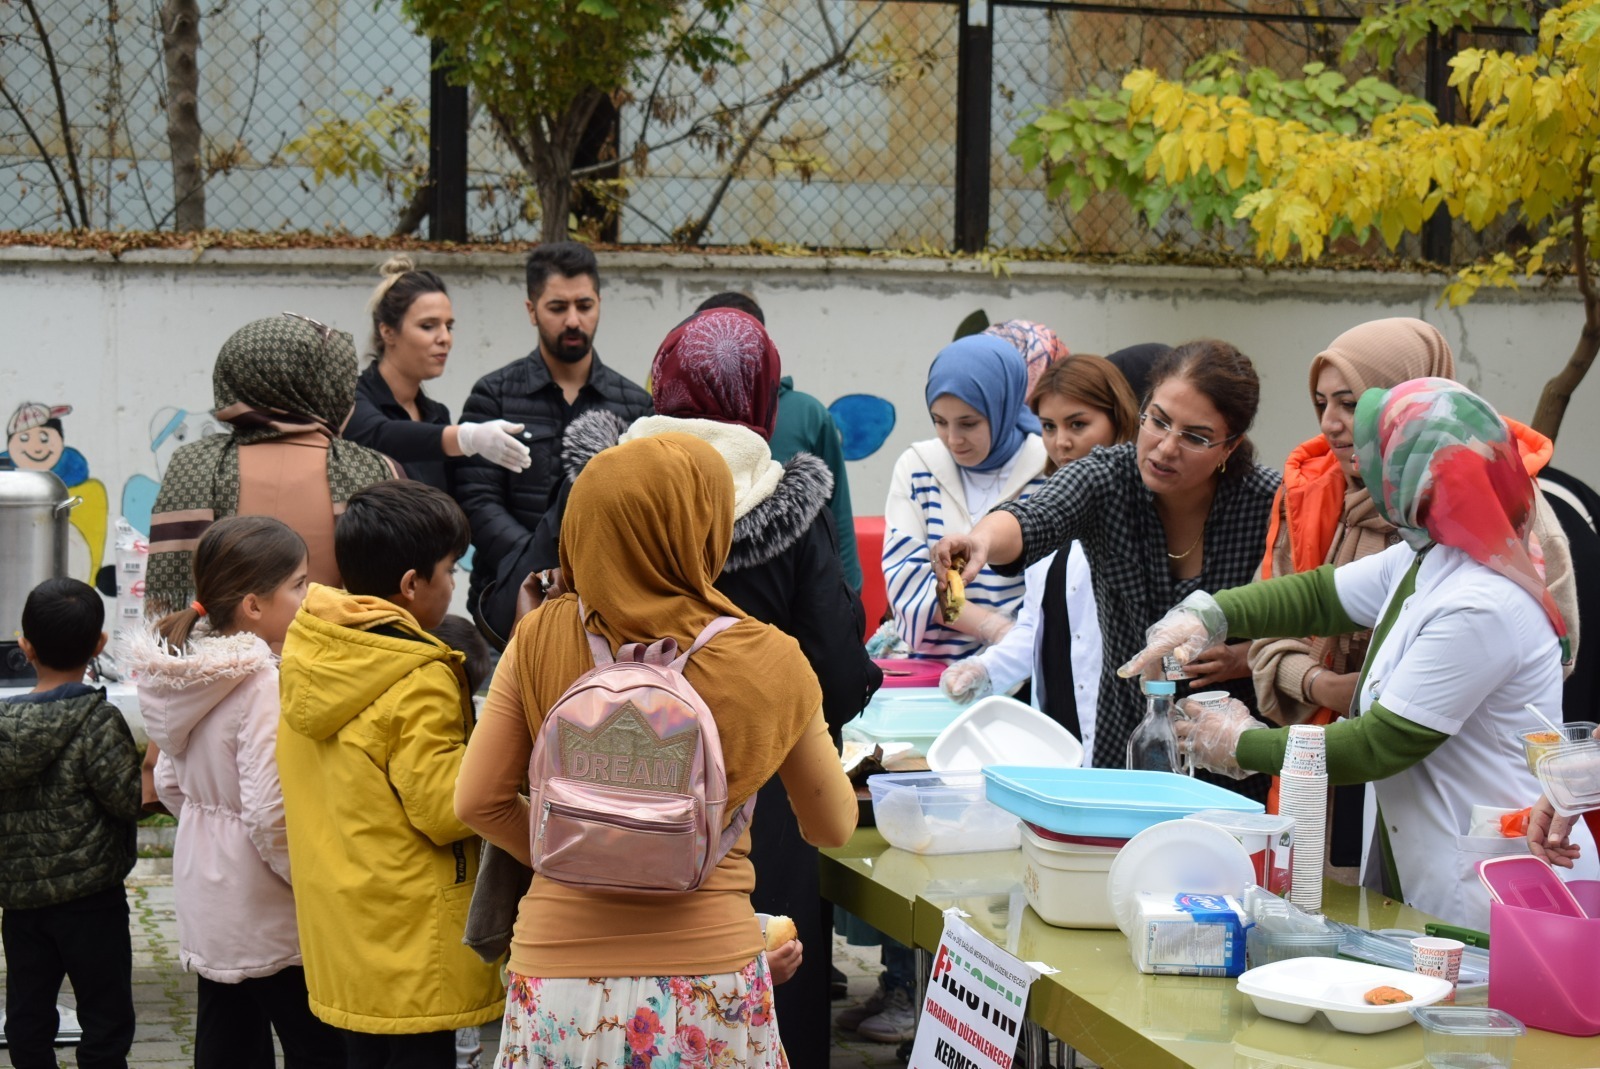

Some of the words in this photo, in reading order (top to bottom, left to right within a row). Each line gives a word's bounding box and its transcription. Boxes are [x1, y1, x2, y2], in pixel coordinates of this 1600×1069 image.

[572, 750, 678, 787] DREAM
[1416, 957, 1444, 966] Chocolate
[1417, 966, 1443, 977] Coffee
[927, 997, 958, 1033] YARARINA
[957, 1021, 1012, 1069] DÜZENLENECEK
